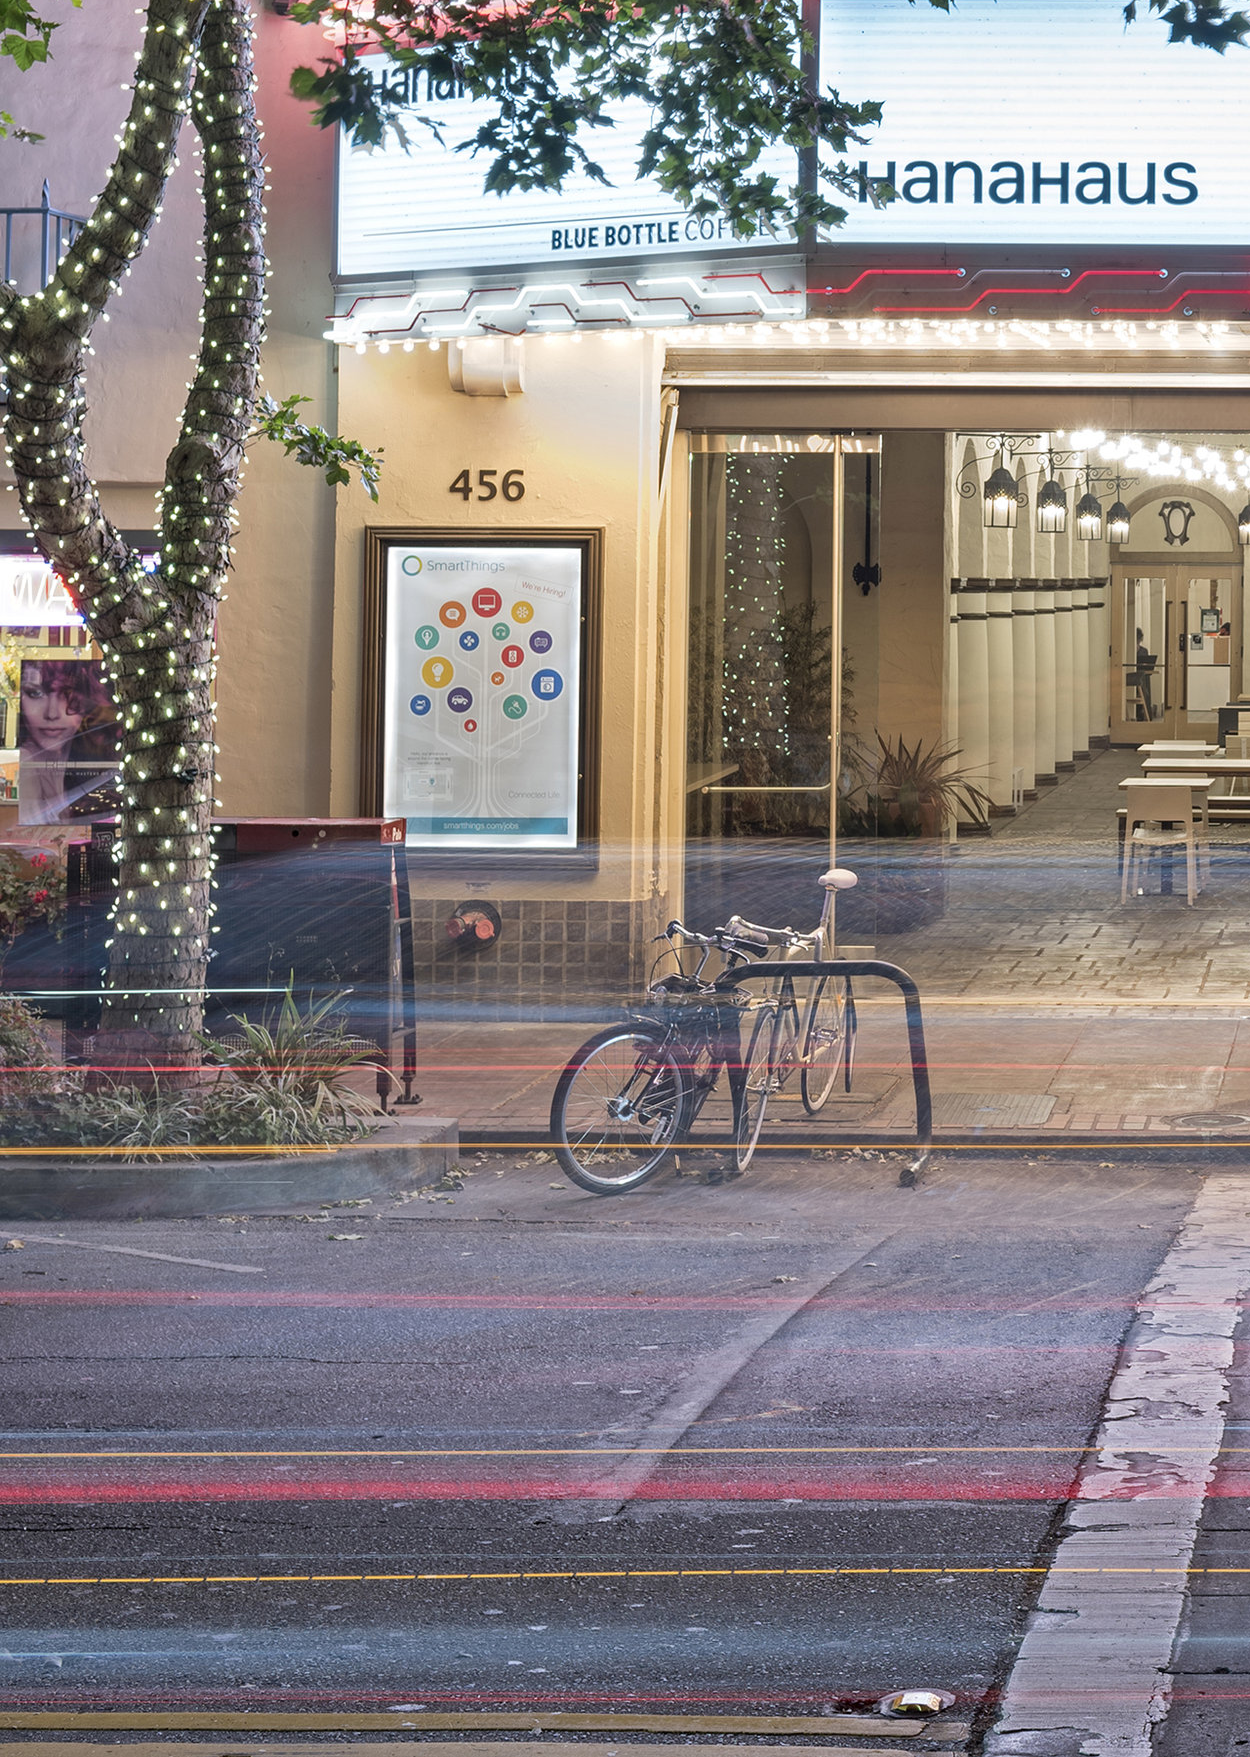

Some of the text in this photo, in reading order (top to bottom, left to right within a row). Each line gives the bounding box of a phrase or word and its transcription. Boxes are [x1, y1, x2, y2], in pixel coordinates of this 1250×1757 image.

[551, 215, 770, 251] BLUE BOTTLE COFE
[449, 468, 526, 502] 456
[427, 559, 506, 574] SmartThings
[521, 580, 567, 598] We're Hiring!
